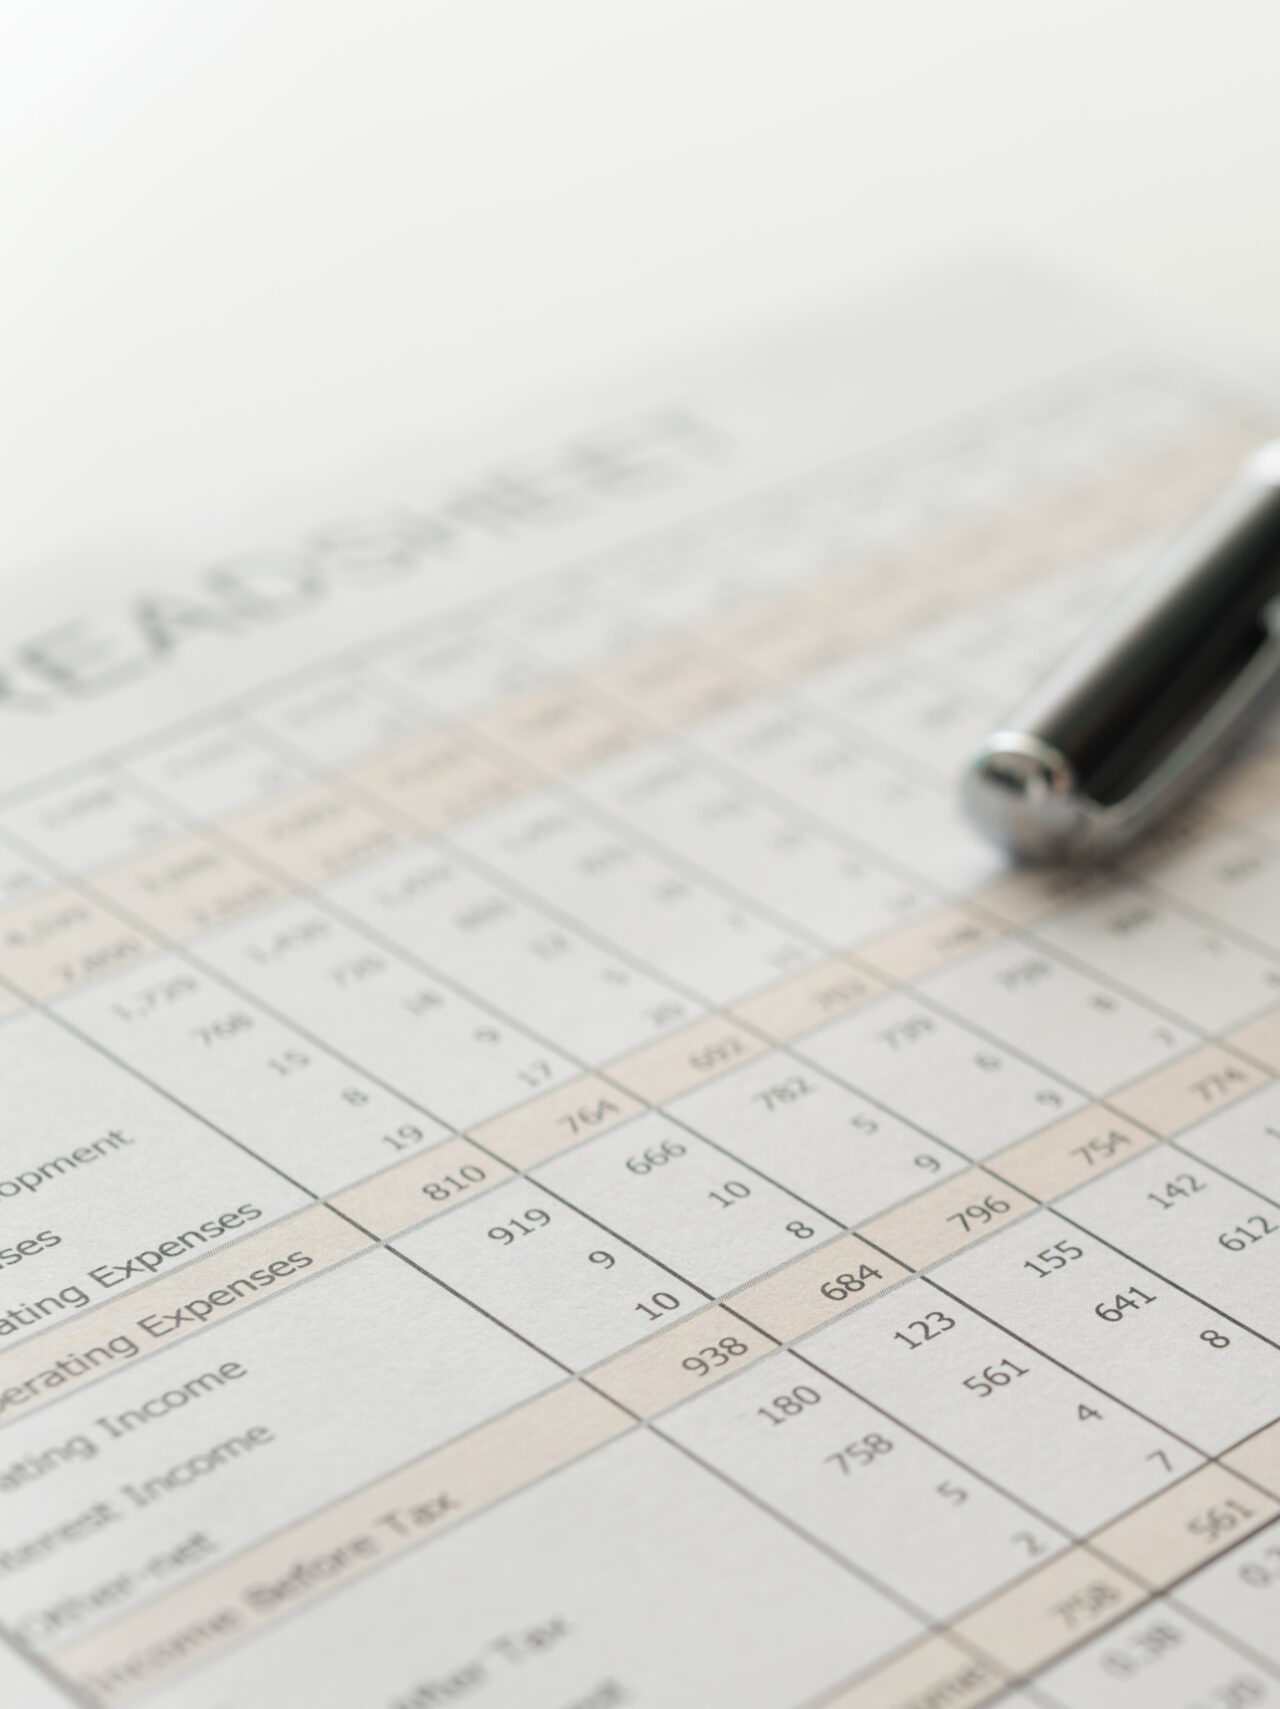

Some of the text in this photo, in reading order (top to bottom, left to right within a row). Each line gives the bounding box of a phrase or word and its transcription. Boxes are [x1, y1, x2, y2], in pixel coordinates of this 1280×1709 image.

[0, 1128, 136, 1198] opment
[381, 1122, 425, 1152] 19
[517, 1059, 553, 1088] 17
[421, 1164, 488, 1202] 810
[555, 1098, 621, 1135] 764
[486, 1208, 552, 1246] 919
[625, 1138, 688, 1176] 666
[752, 1074, 819, 1113] 782
[586, 1249, 617, 1270] 9
[707, 1179, 752, 1209] 10
[848, 1111, 879, 1137] 5
[634, 1291, 682, 1321] 10
[785, 1220, 816, 1241] 8
[912, 1152, 942, 1175] 9
[681, 1335, 750, 1377] 938
[819, 1262, 884, 1302] 684
[945, 1194, 1011, 1234] 796
[1069, 1128, 1133, 1168] 754
[1190, 1065, 1246, 1103] 774
[0, 1229, 62, 1271] ses
[0, 1202, 264, 1337] ating Expenses
[136, 1250, 314, 1340] Expenses
[756, 1384, 823, 1427] 180
[892, 1310, 957, 1351] 123
[1022, 1238, 1085, 1280] 155
[1147, 1171, 1208, 1212] 142
[93, 1360, 249, 1440] Income
[823, 1432, 895, 1477] 758
[961, 1357, 1031, 1399] 561
[1094, 1285, 1158, 1324] 641
[1217, 1215, 1280, 1252] 612
[120, 1424, 277, 1508] Income
[935, 1480, 971, 1508] 5
[1077, 1402, 1104, 1422] 4
[1199, 1329, 1231, 1350] 8
[242, 1531, 382, 1615] Before
[376, 1490, 461, 1540] Tax
[1012, 1529, 1048, 1558] 2
[1144, 1448, 1174, 1474] 7
[1185, 1497, 1256, 1544] 561
